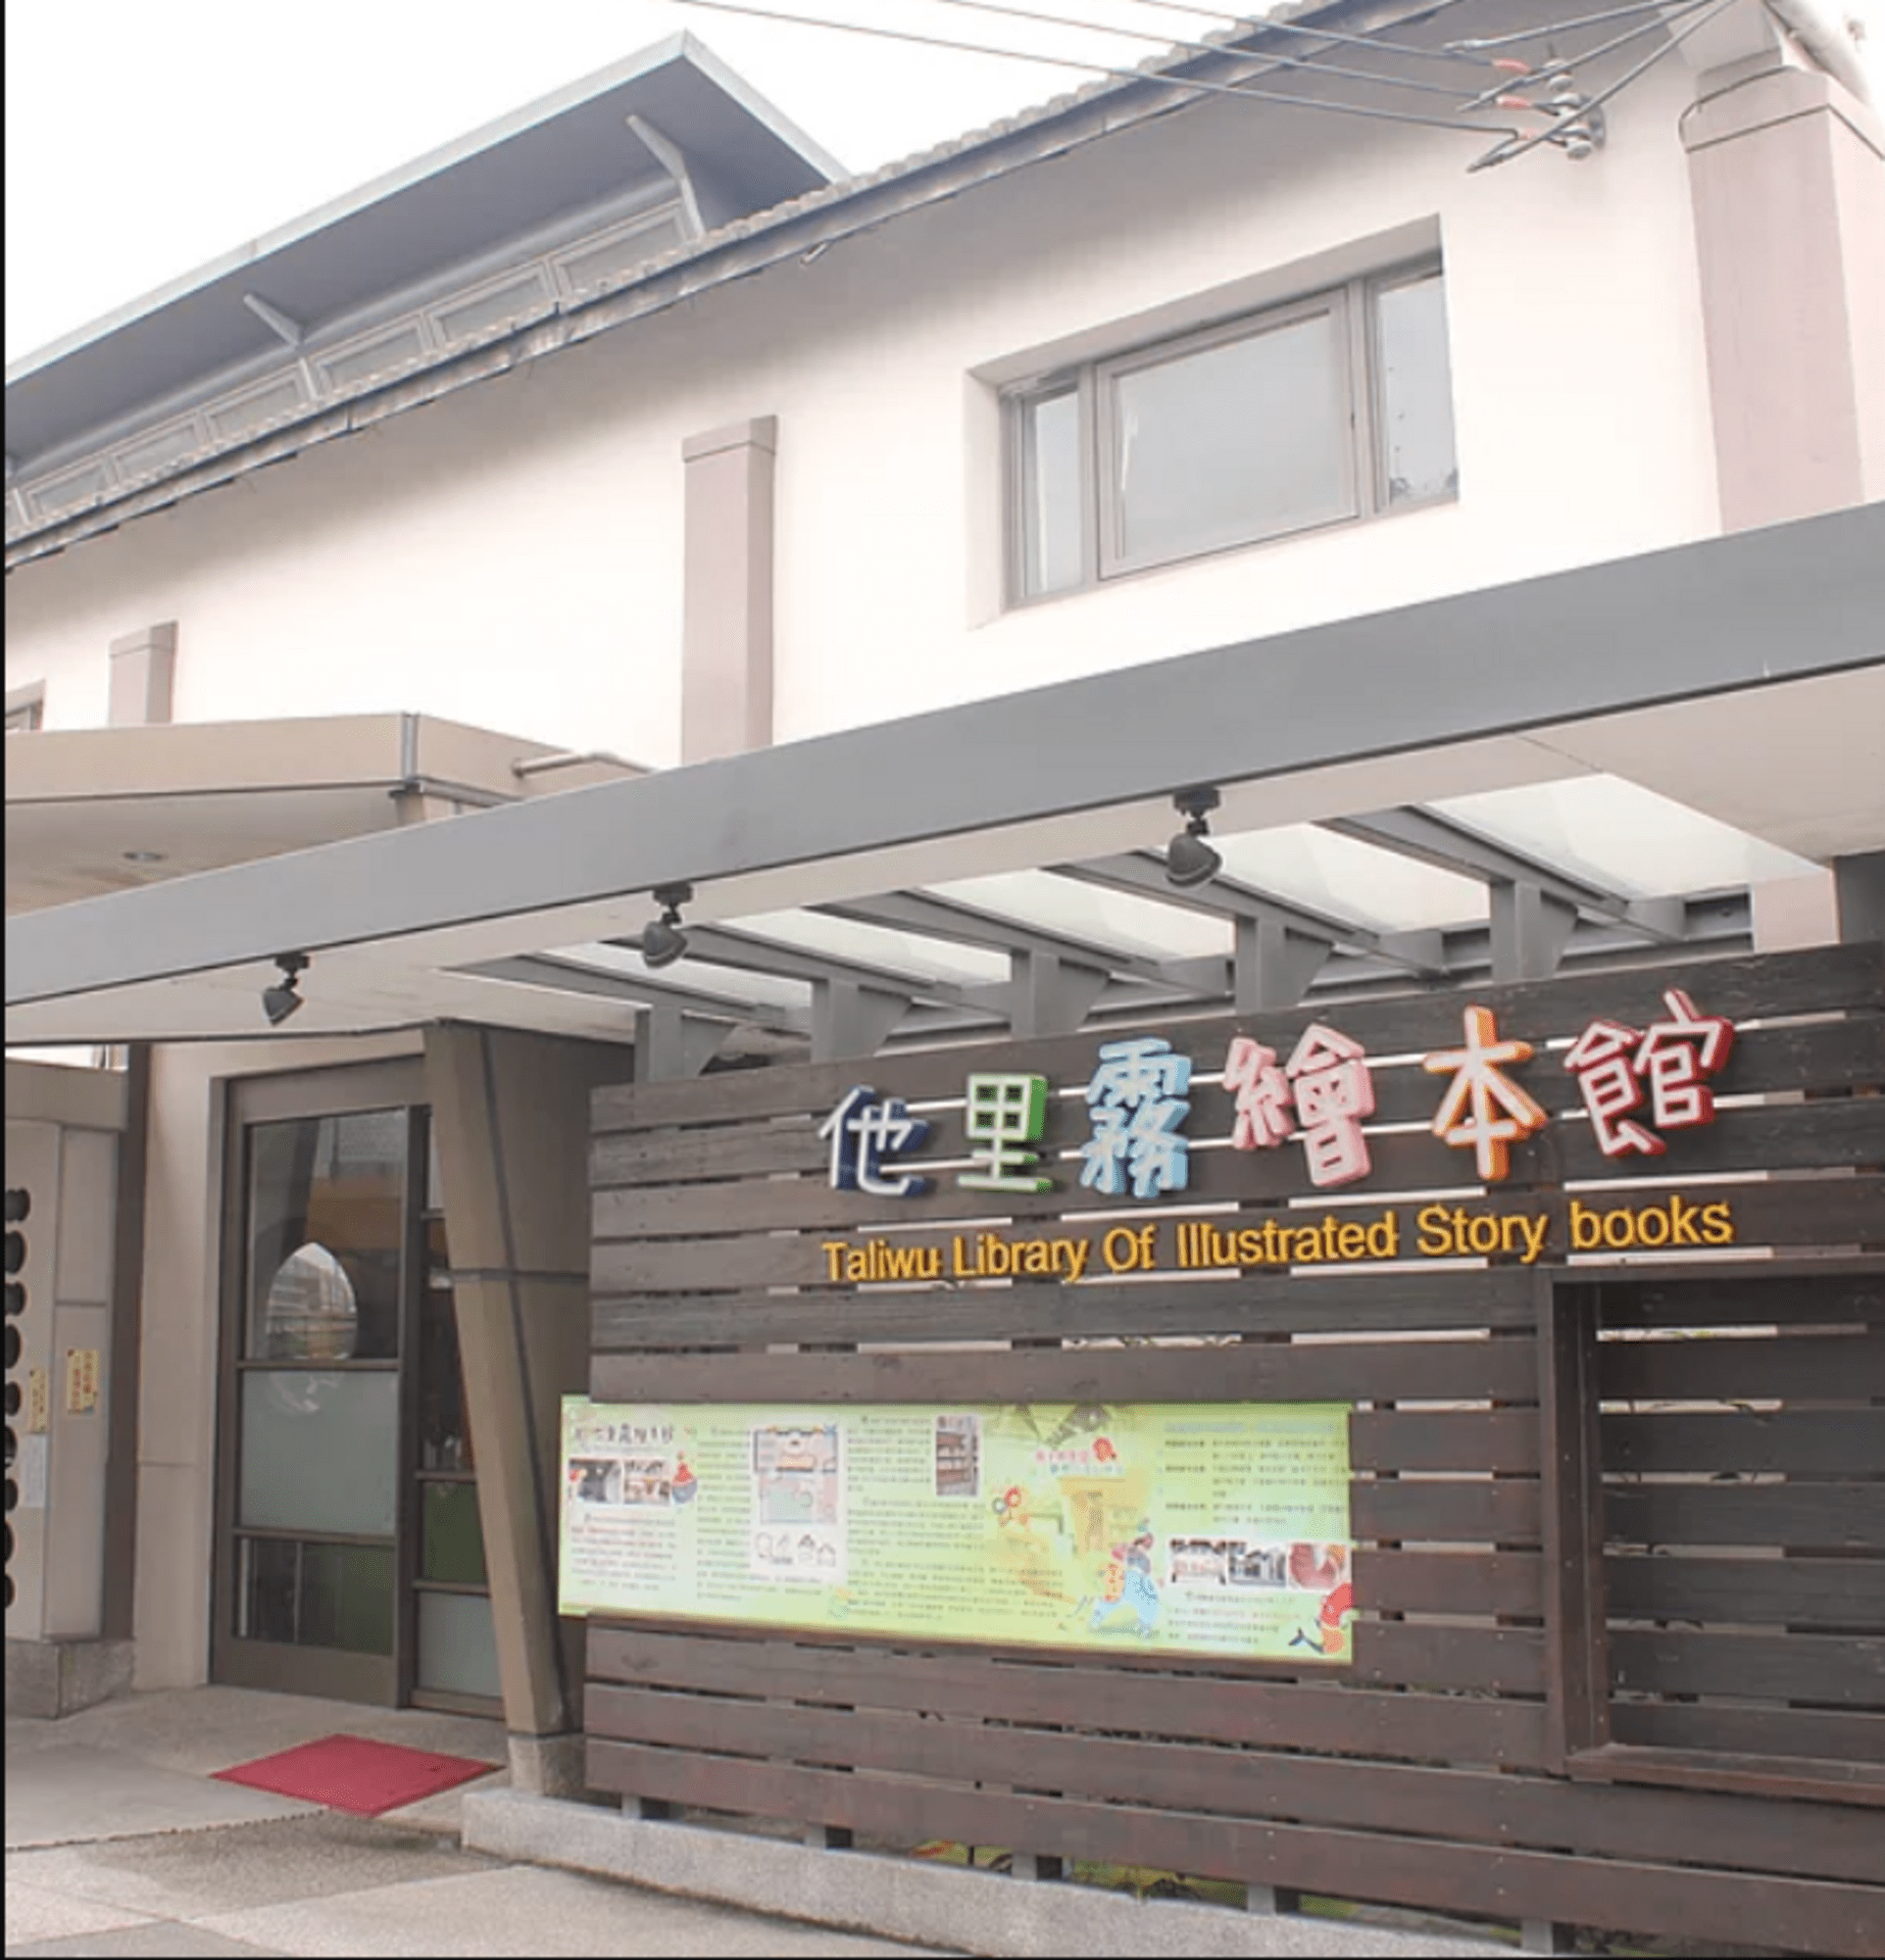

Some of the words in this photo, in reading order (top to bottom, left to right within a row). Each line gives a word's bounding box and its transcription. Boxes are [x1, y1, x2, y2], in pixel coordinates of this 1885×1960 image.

[818, 990, 1733, 1197] 他里霧繪本館
[822, 1240, 942, 1282] Taliwu
[952, 1232, 1088, 1281] Library
[1103, 1223, 1157, 1271] Of
[1177, 1210, 1398, 1266] Illustrated
[1416, 1202, 1549, 1264] Story
[1569, 1195, 1734, 1250] books
